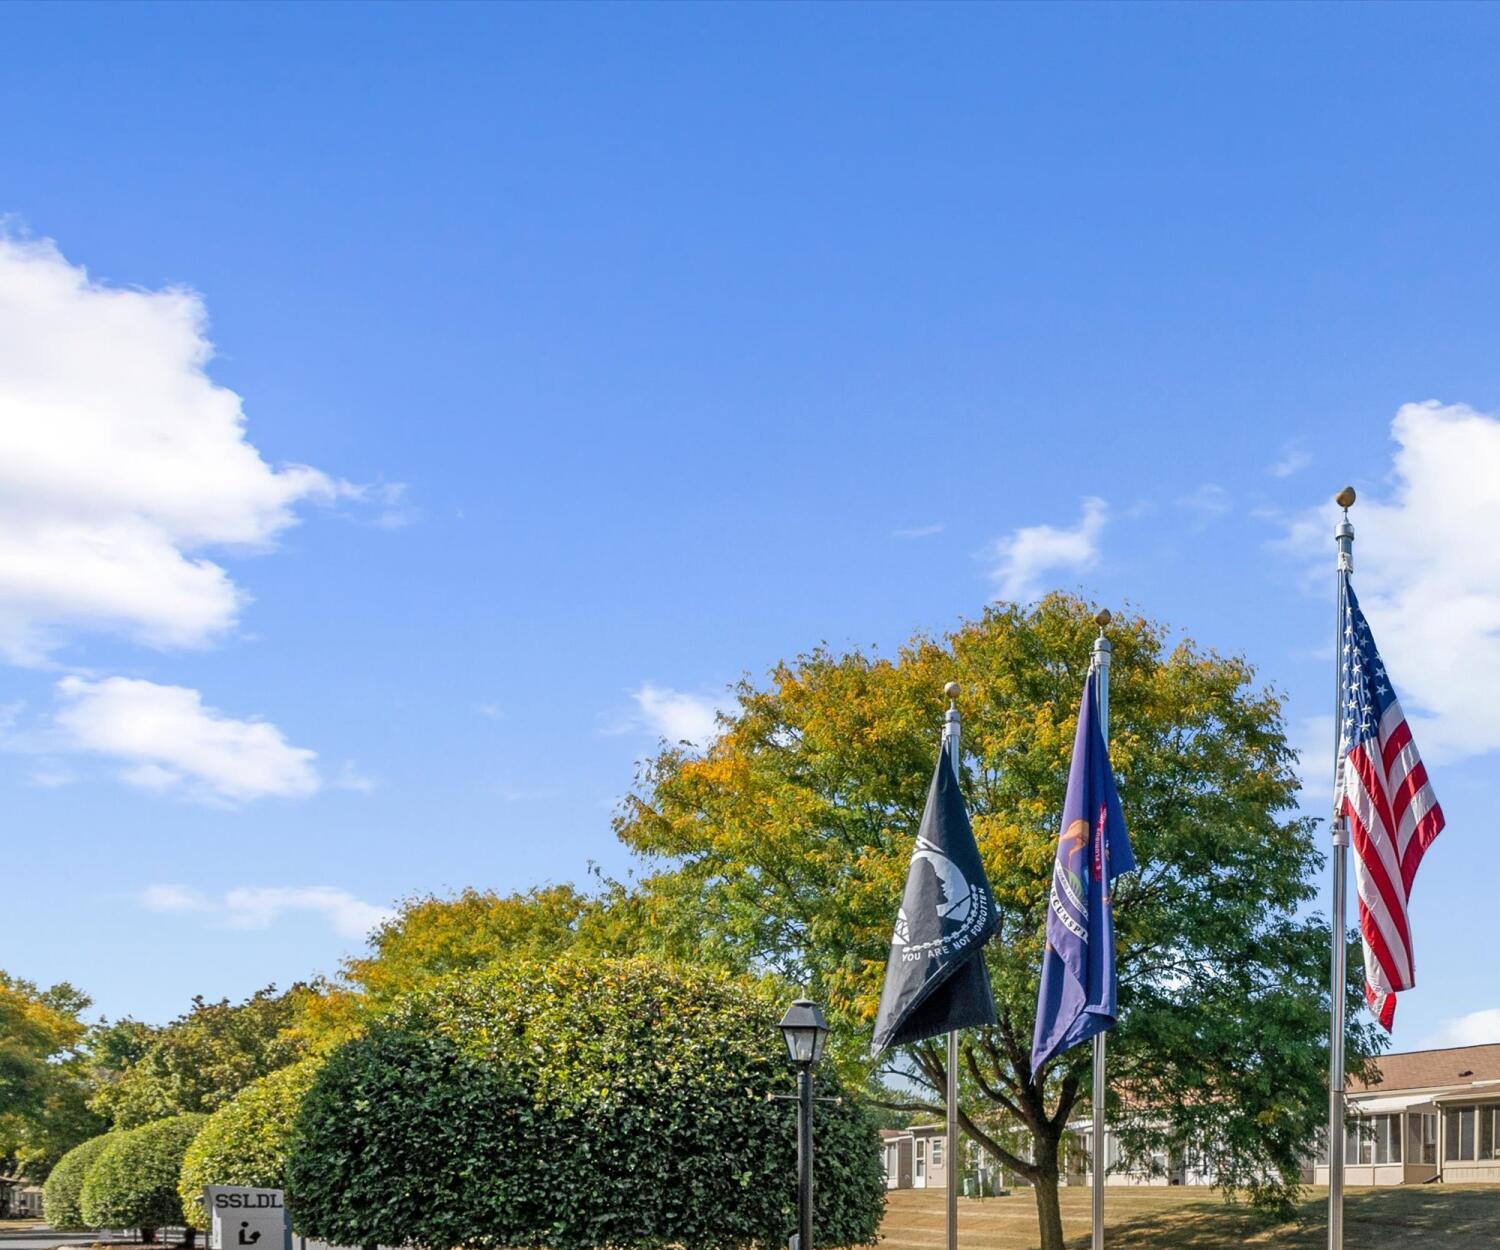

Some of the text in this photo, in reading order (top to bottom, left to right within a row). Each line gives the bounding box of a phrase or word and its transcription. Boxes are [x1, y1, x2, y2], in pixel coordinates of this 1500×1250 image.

[902, 887, 988, 963] YOU ARE NOT FORGOTTEN
[215, 1194, 283, 1208] SSLDL
